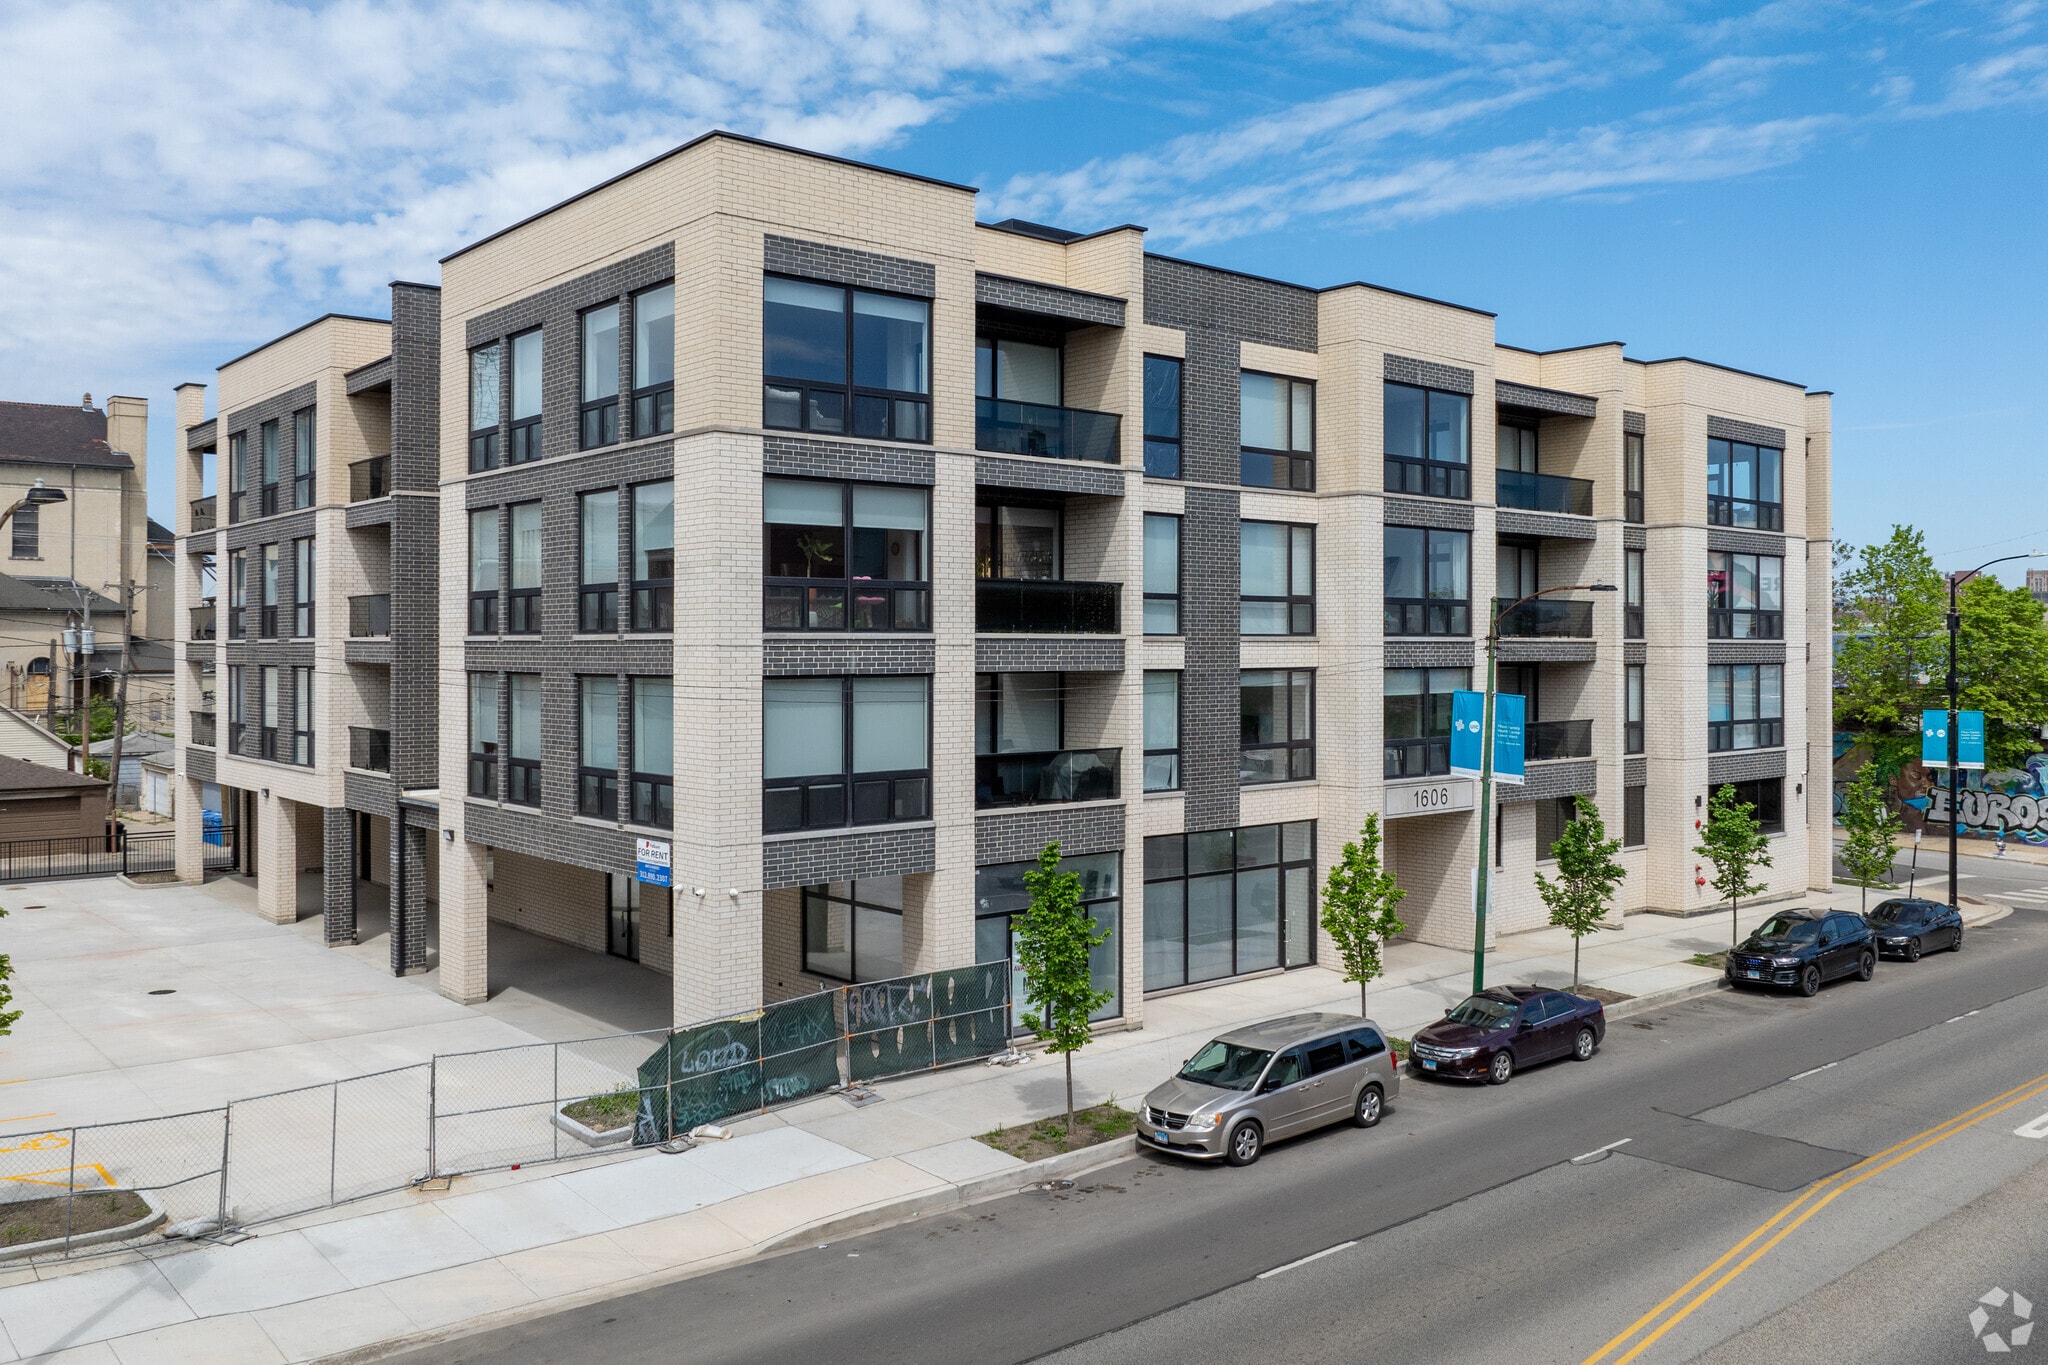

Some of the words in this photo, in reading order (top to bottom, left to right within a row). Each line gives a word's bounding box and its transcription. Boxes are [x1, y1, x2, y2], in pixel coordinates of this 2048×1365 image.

[1413, 787, 1448, 808] 1606
[638, 847, 650, 857] FOR
[651, 850, 668, 861] RENT
